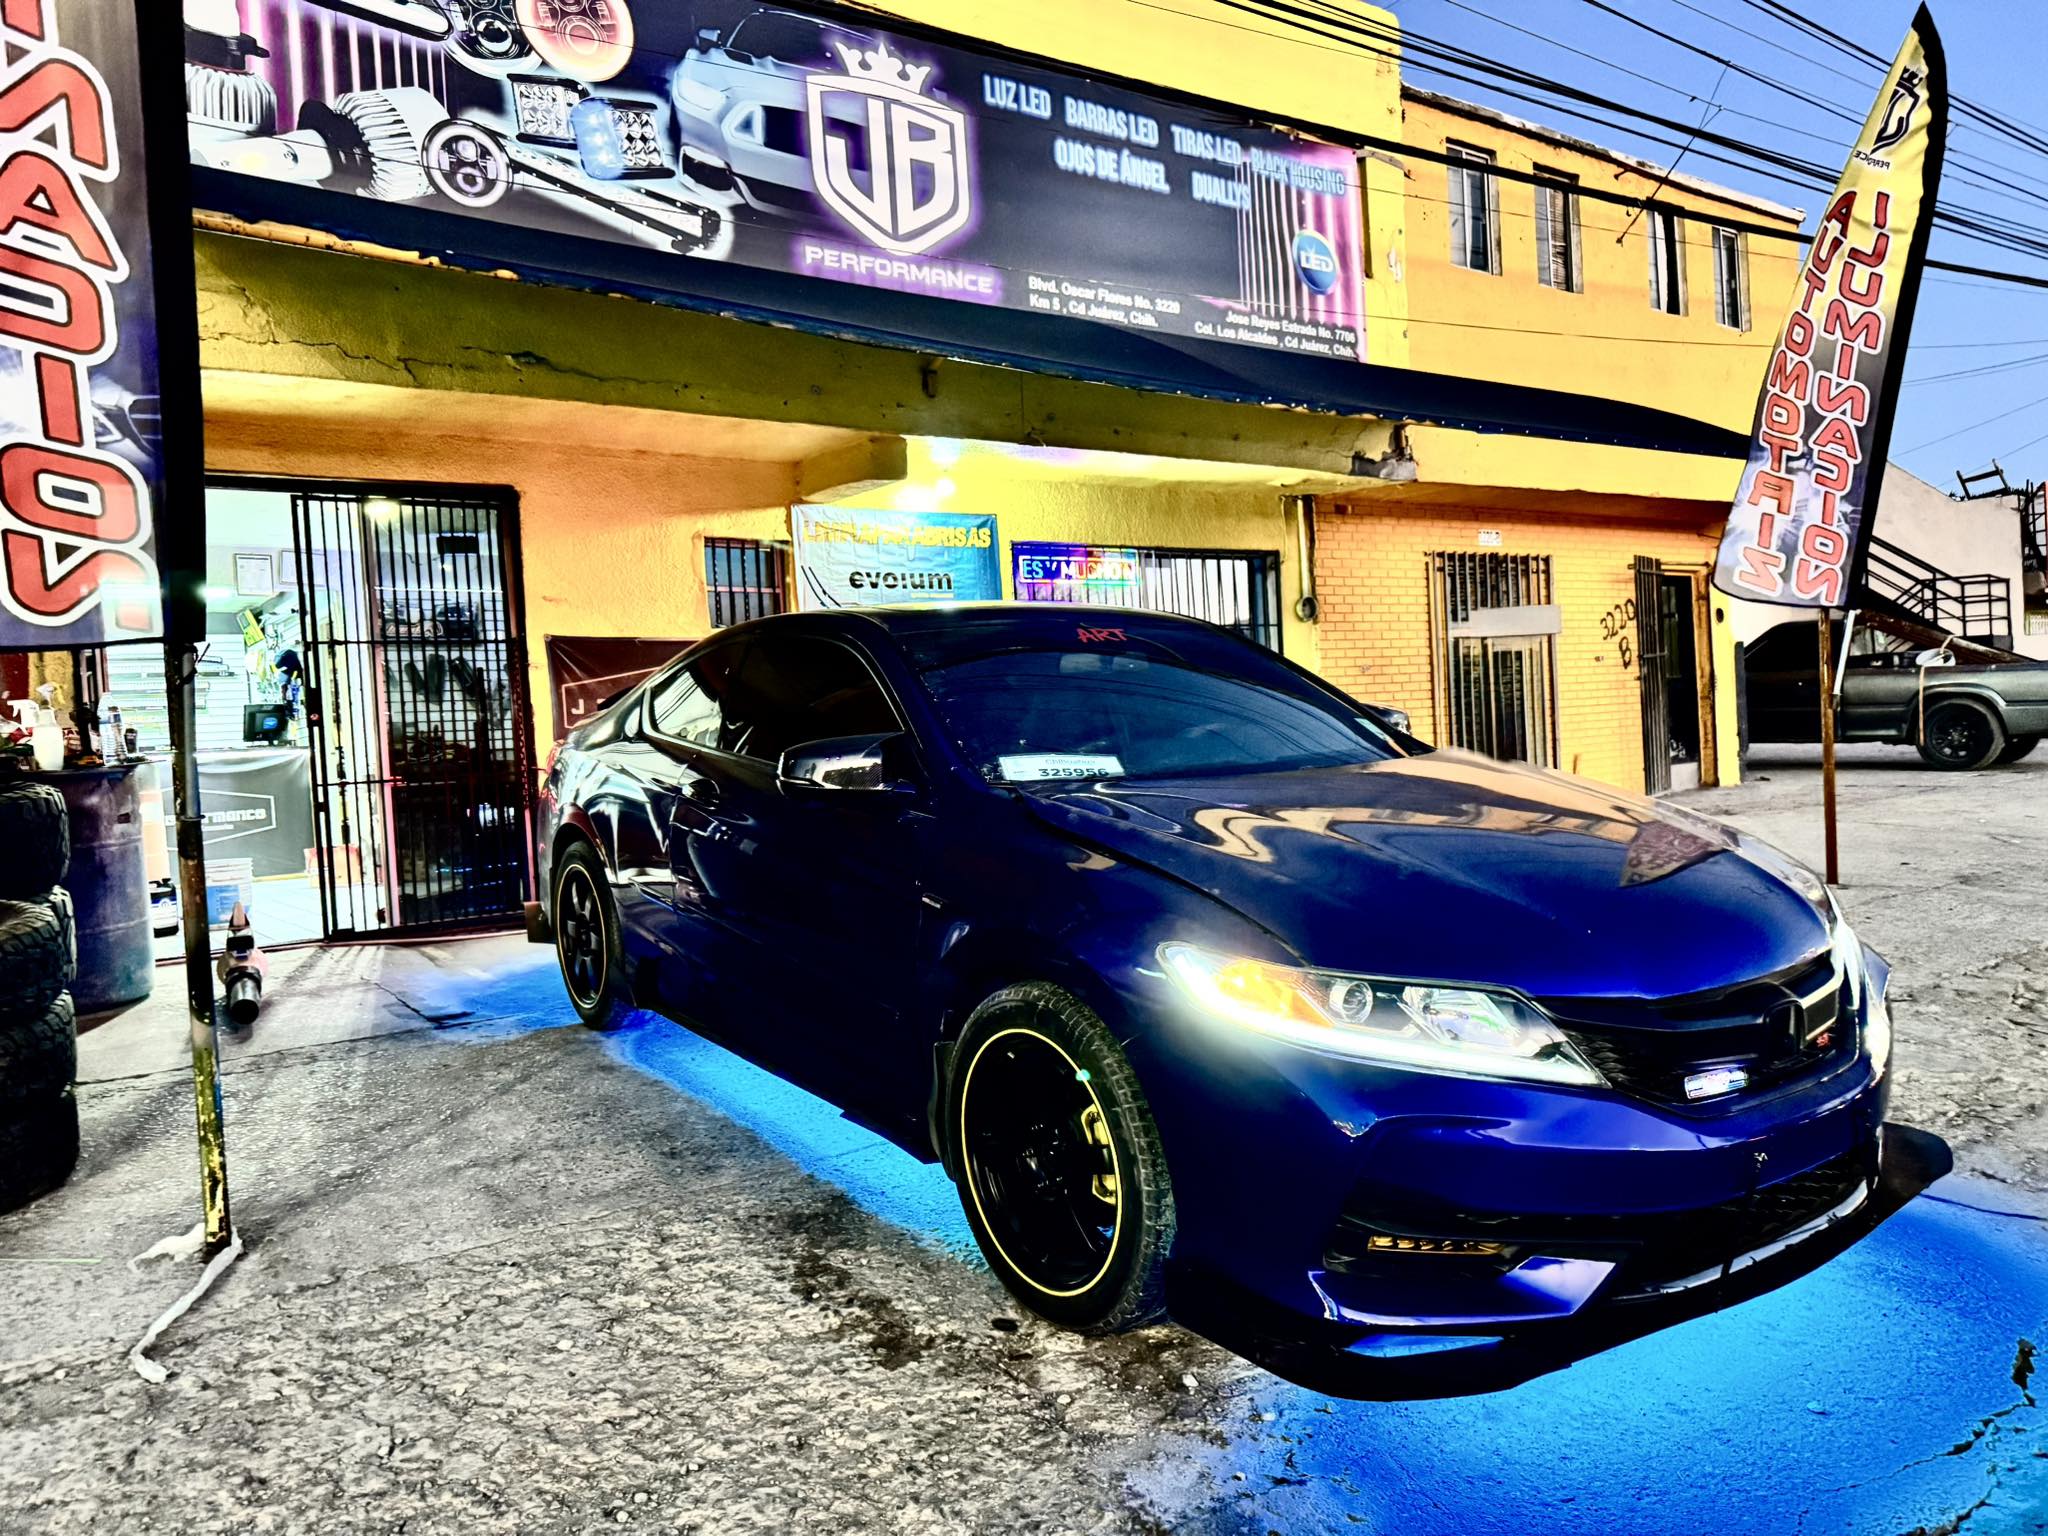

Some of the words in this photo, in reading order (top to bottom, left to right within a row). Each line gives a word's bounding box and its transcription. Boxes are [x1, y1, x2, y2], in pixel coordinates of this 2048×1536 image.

[983, 74, 1017, 112] LUZ
[1018, 83, 1052, 120] LED
[1064, 96, 1128, 140] BARRAS
[1127, 113, 1160, 146] LED
[1170, 124, 1215, 161] TIRAS
[1215, 137, 1243, 166] LED
[825, 98, 956, 237] JB
[1053, 138, 1096, 176] OJOS
[1096, 148, 1120, 181] DE
[1120, 150, 1170, 195] ÁNGEL
[1250, 146, 1289, 181] BLACK
[1289, 160, 1346, 196] HOUSING
[1191, 171, 1251, 210] DUALLYS
[804, 245, 994, 295] PERFORMANCE
[1299, 250, 1335, 273] LED
[1028, 276, 1060, 293] Blvd.
[1060, 282, 1097, 300] Oscar
[1097, 288, 1134, 307] Flores
[1134, 294, 1154, 311] No.
[1154, 298, 1182, 314] 3220
[1029, 293, 1051, 310] Km
[1068, 300, 1087, 315] Cd
[1129, 310, 1160, 327] Chih.
[1194, 320, 1217, 337] Col.
[1217, 324, 1236, 339] Los
[1284, 335, 1299, 348] Cd
[1251, 315, 1281, 332] Reyes
[1282, 320, 1317, 337] Estrada
[1318, 326, 1334, 340] No.
[1076, 627, 1128, 643] ART
[1600, 598, 1637, 641] 3220
